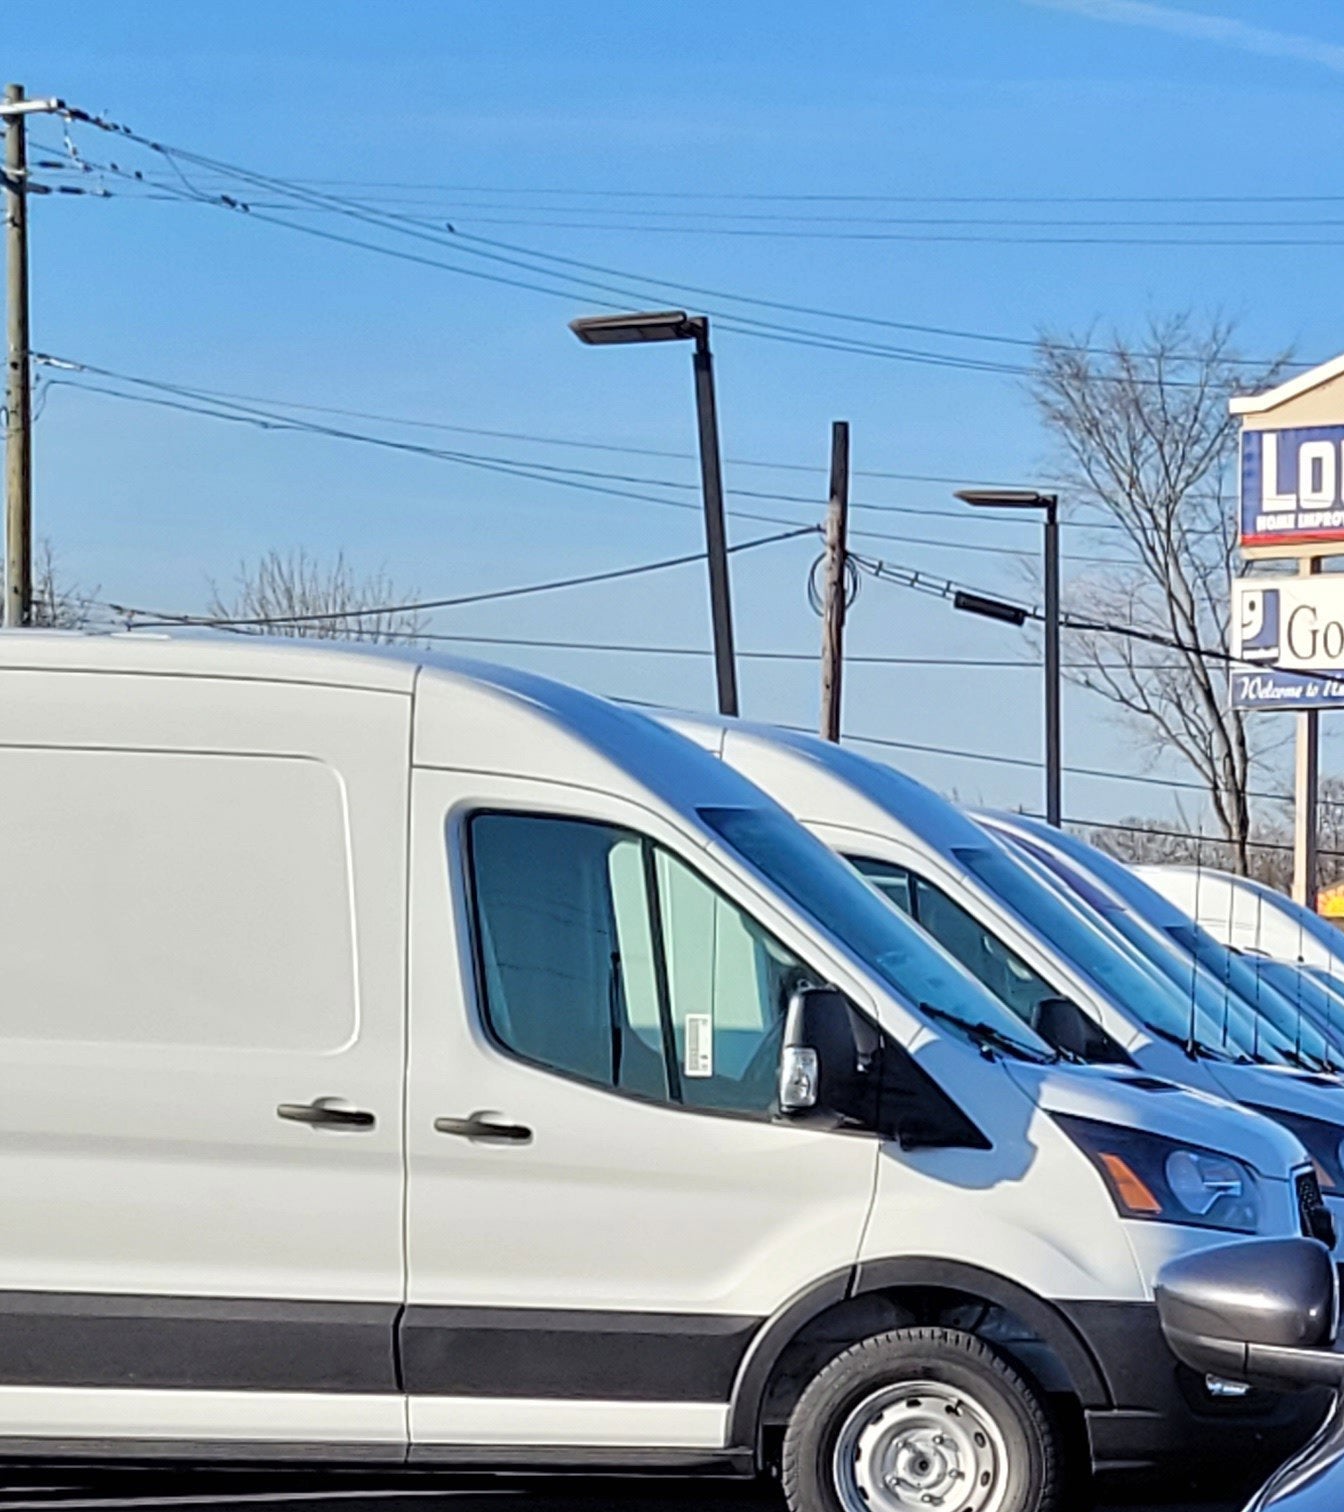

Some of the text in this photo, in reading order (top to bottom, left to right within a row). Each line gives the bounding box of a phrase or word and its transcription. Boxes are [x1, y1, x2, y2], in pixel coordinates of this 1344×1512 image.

[1256, 513, 1296, 532] HOME
[1239, 676, 1303, 700] Welcome
[1305, 682, 1318, 697] to
